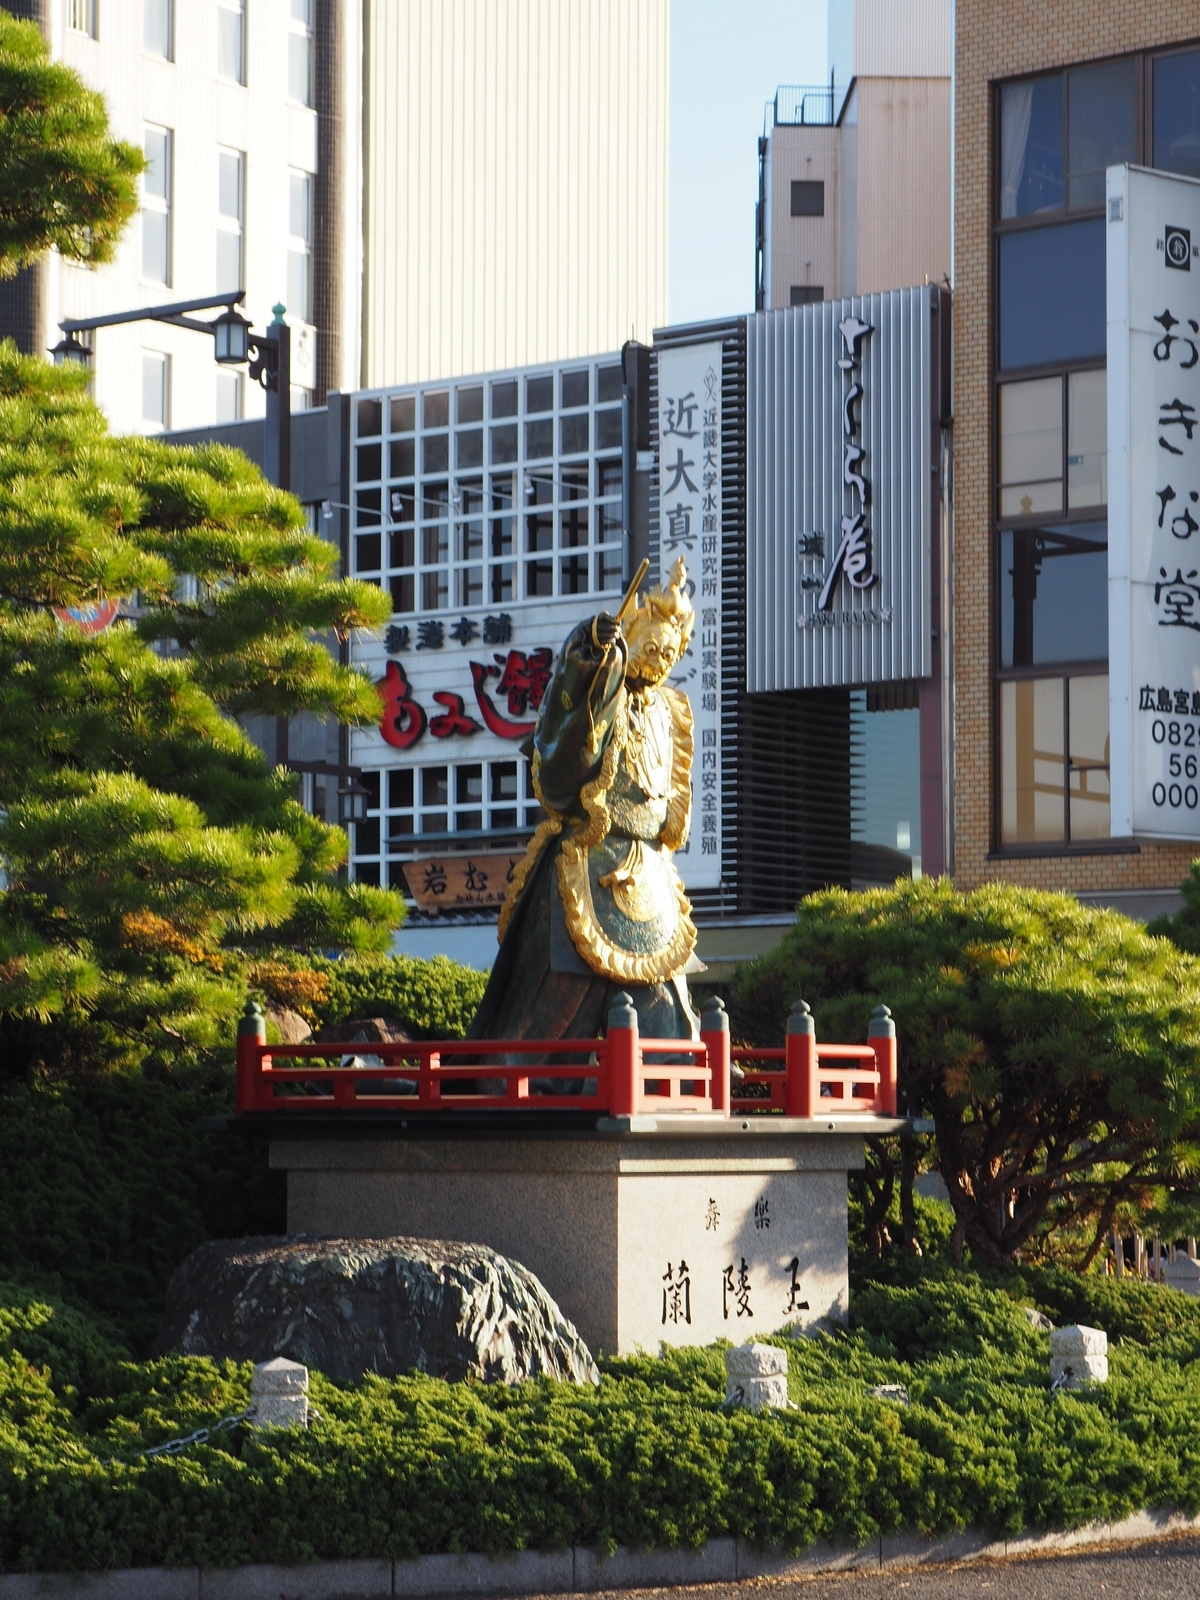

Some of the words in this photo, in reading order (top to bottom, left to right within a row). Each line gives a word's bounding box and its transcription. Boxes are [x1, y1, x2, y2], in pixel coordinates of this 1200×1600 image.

[701, 409, 718, 597] 近畿大学水産研究所
[819, 316, 878, 611] さくら庵
[1153, 308, 1200, 632] おきな堂
[376, 647, 558, 749] もみじ饅
[701, 607, 717, 712] 富山実験場
[1152, 719, 1200, 747] 082
[1169, 752, 1198, 779] 56
[701, 729, 717, 855] 国内安全養殖
[661, 1256, 810, 1325] 蘭陵王
